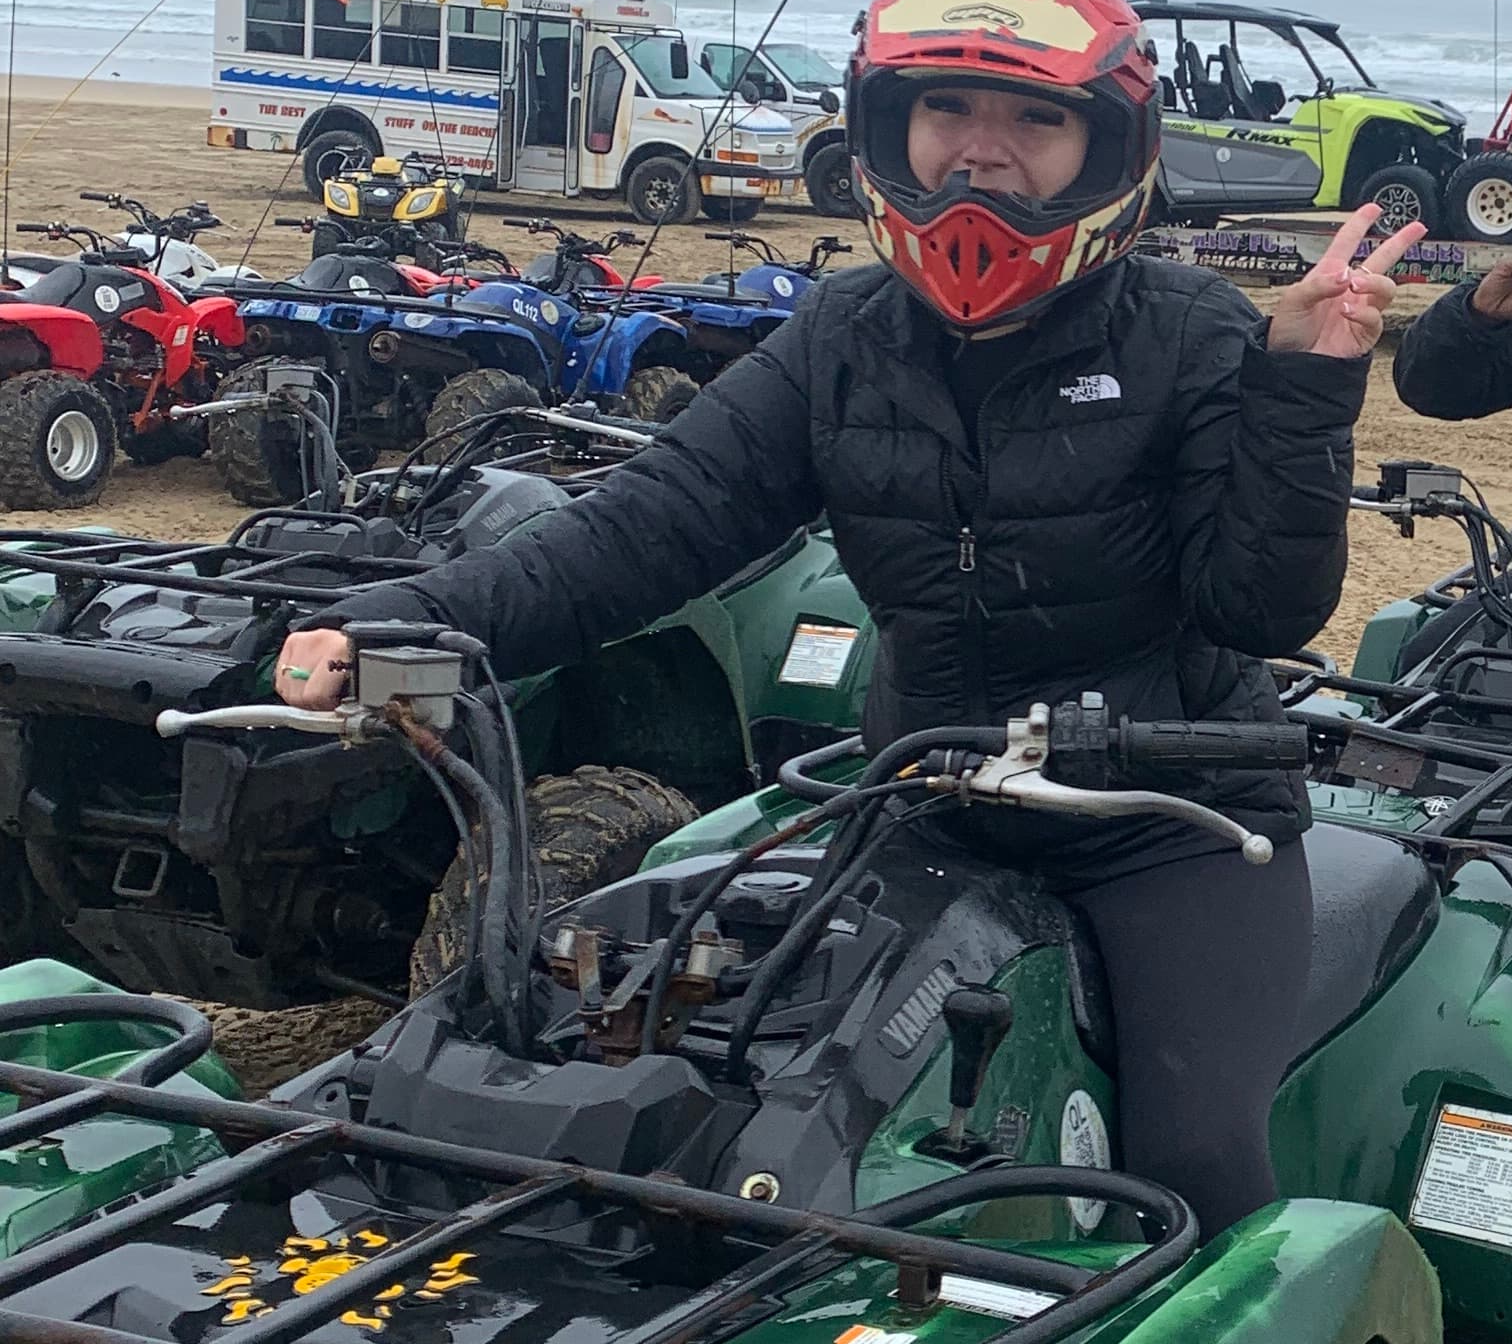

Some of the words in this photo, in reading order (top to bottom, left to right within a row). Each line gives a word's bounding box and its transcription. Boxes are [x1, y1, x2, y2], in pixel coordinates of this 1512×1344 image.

[281, 106, 307, 118] BEST
[384, 117, 415, 129] STUFF
[439, 122, 458, 134] THE
[512, 298, 539, 322] QL112
[1059, 385, 1101, 398] NORTH
[1076, 375, 1100, 387] THE
[1070, 393, 1101, 404] FACE
[480, 502, 517, 532] YAMAHA
[882, 962, 957, 1050] YAMAHA
